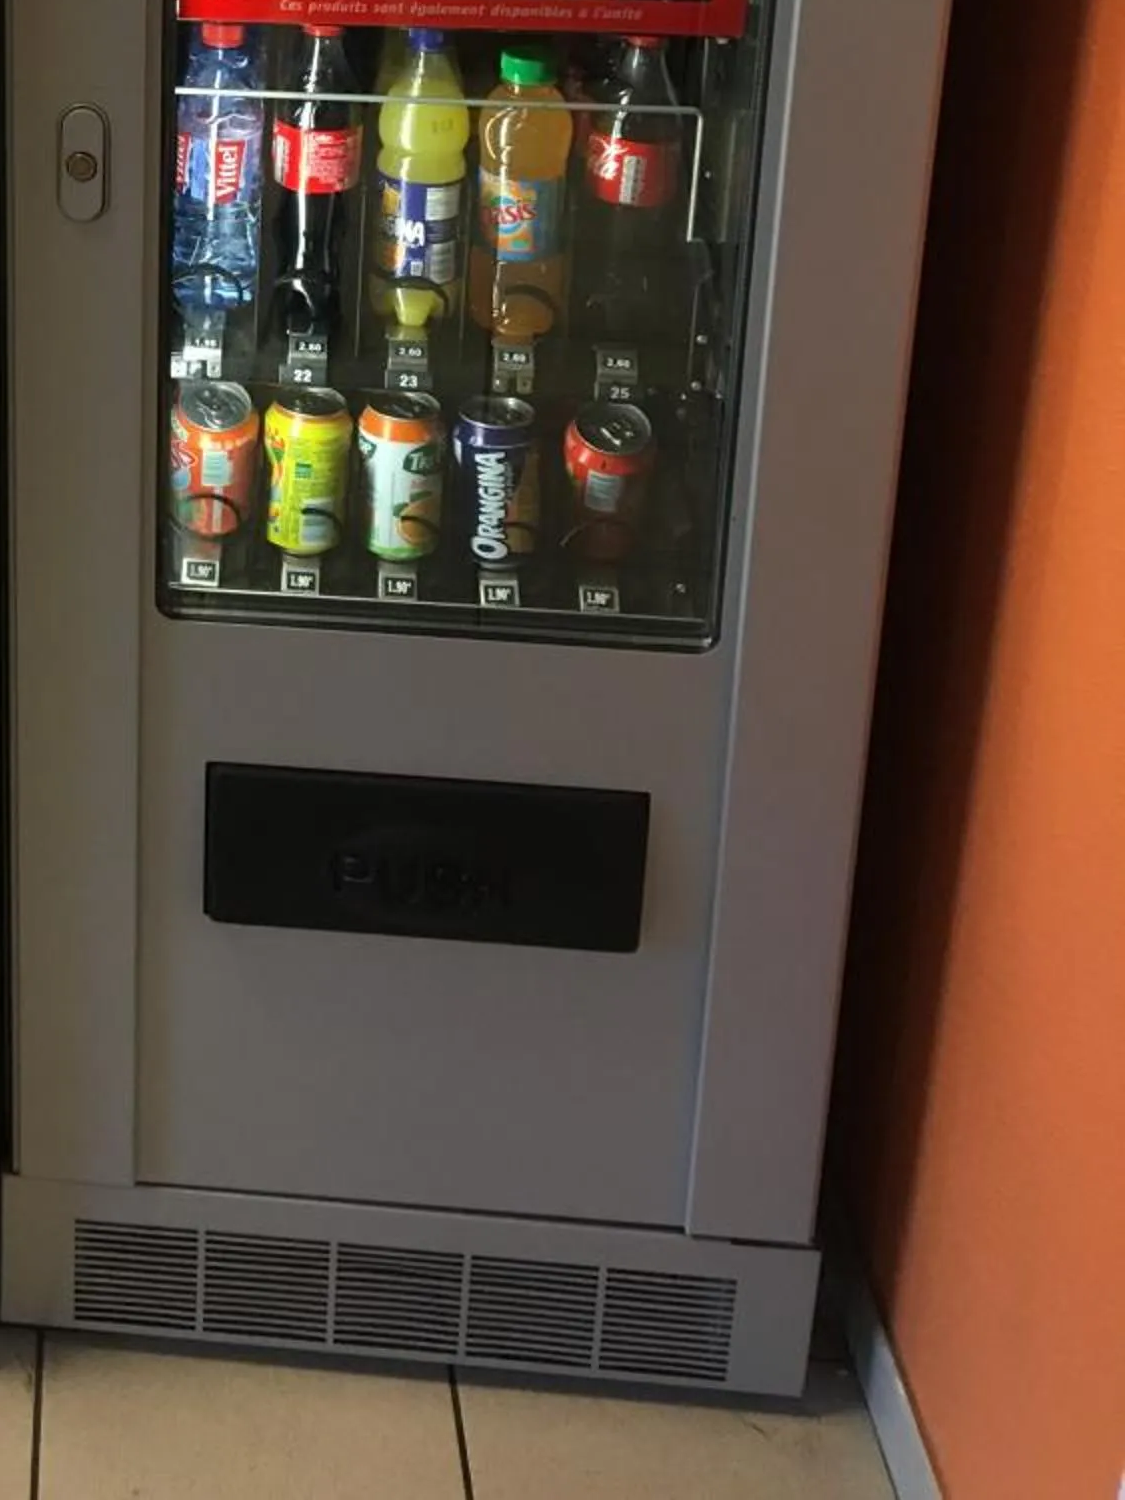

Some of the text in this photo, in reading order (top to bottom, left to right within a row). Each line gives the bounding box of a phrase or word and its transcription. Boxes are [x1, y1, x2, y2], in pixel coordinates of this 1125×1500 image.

[279, 0, 302, 11] Ces
[308, 0, 367, 14] produits
[215, 145, 238, 197] Vittel
[294, 369, 312, 382] 22
[399, 375, 418, 388] 23
[611, 387, 630, 399] 25
[470, 452, 508, 560] ORANGINA
